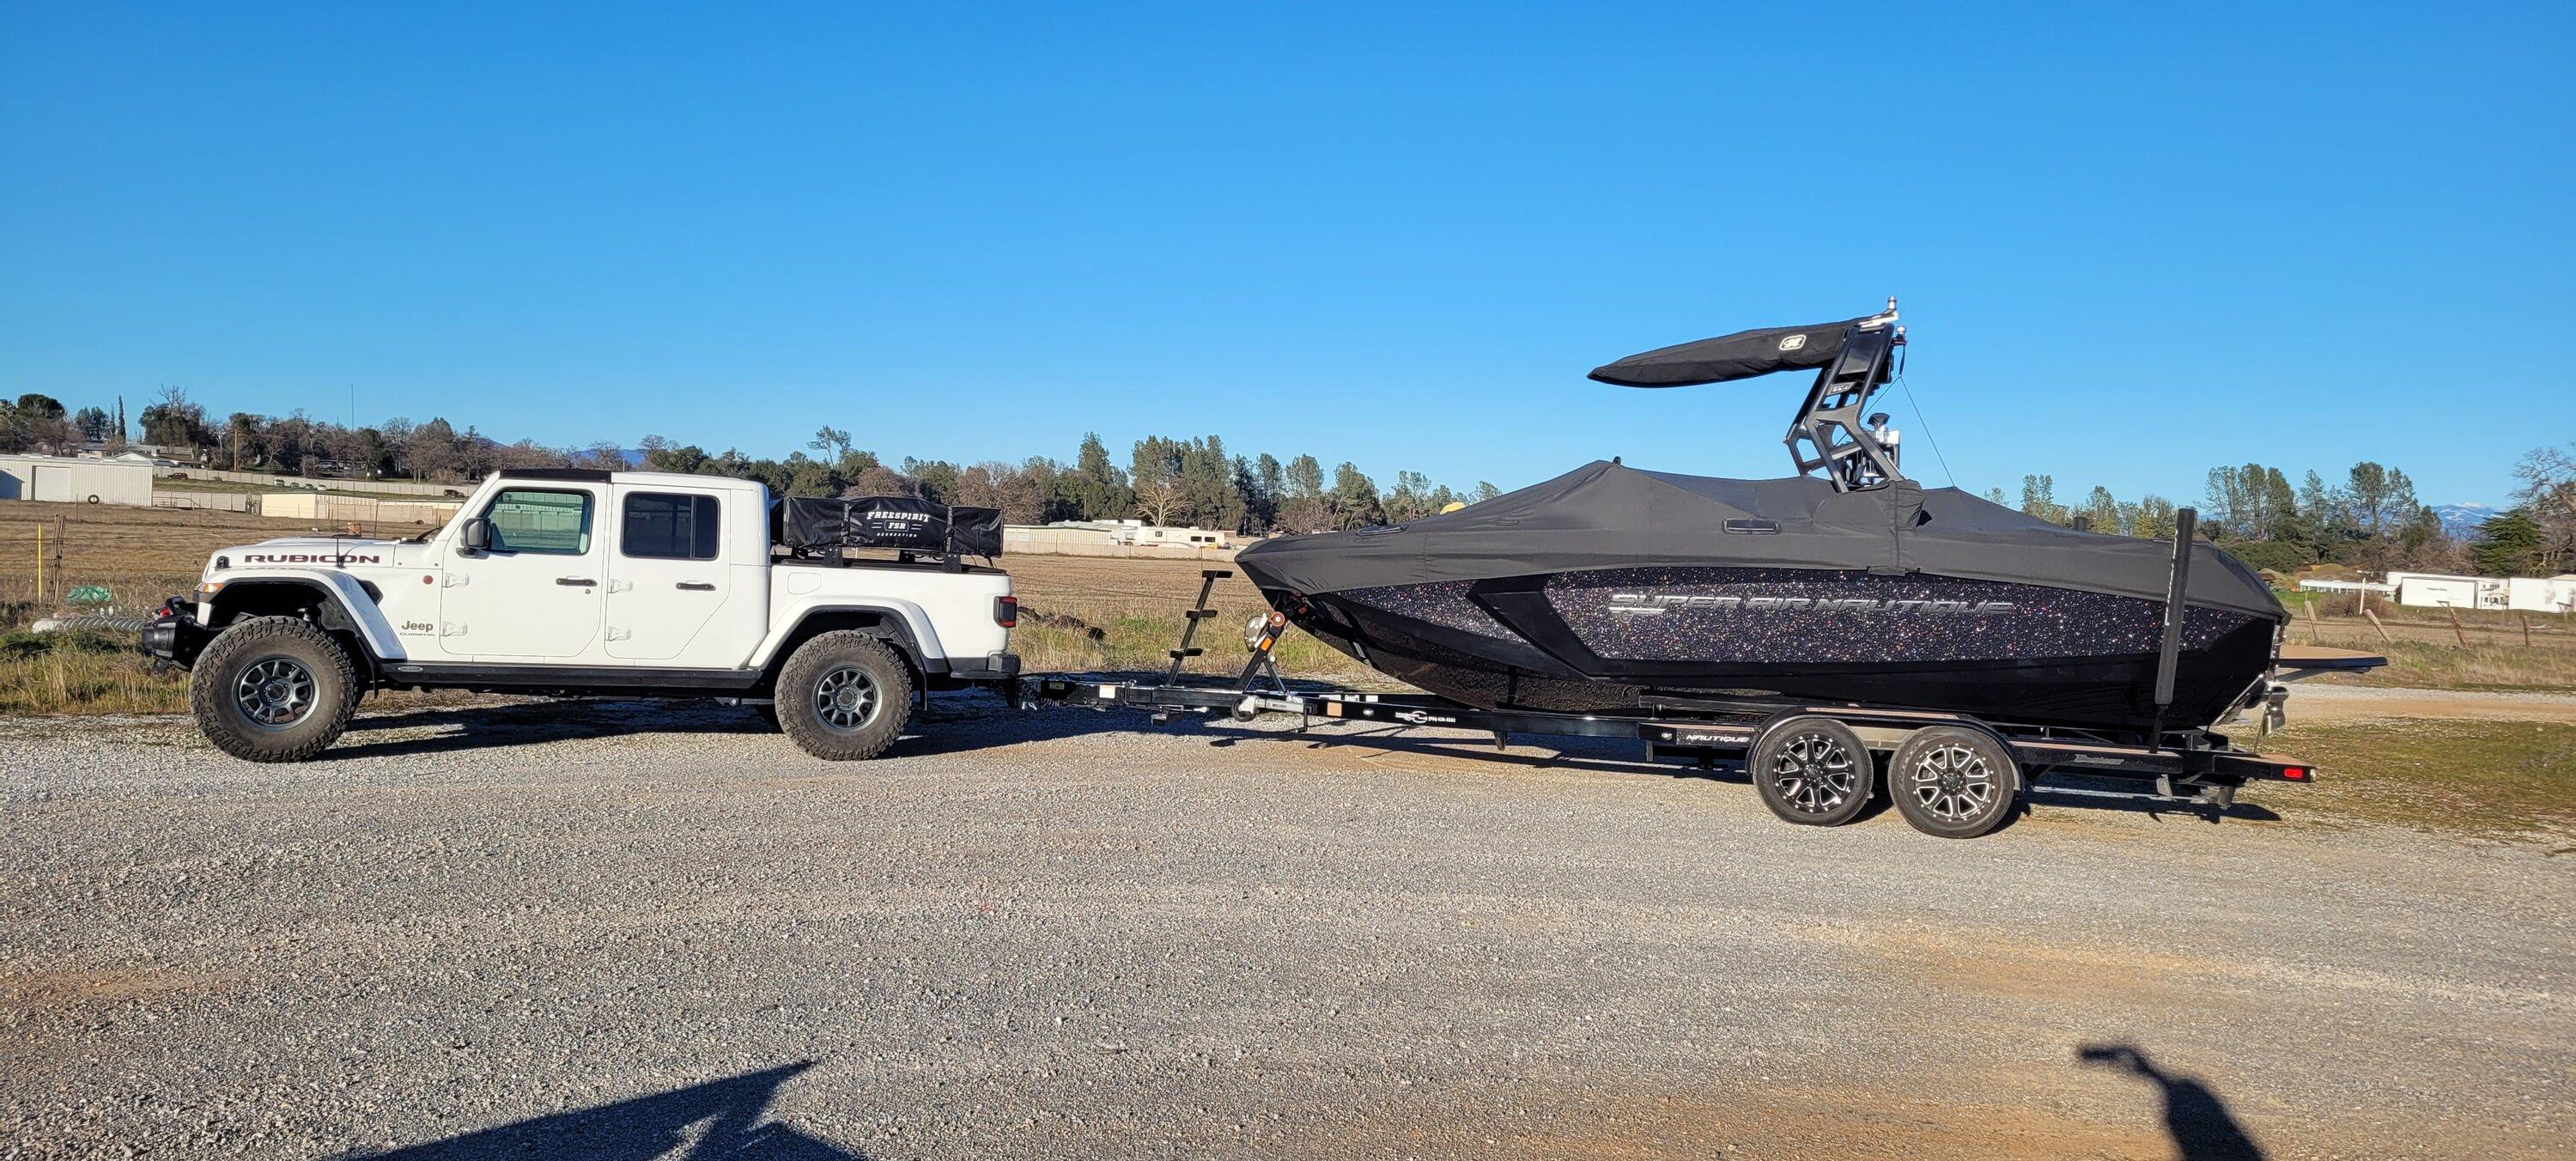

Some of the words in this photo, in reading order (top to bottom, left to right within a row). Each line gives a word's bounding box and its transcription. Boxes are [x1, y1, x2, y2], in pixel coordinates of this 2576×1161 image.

[866, 511, 930, 523] FREESPIRIT
[244, 554, 380, 564] RUBICON
[1612, 594, 1741, 609] SUPER
[1747, 597, 1811, 611] AIR
[1814, 599, 2014, 616] NAUTIQUE
[401, 620, 434, 632] Jeep
[1686, 734, 1750, 743] NAUTIQUE
